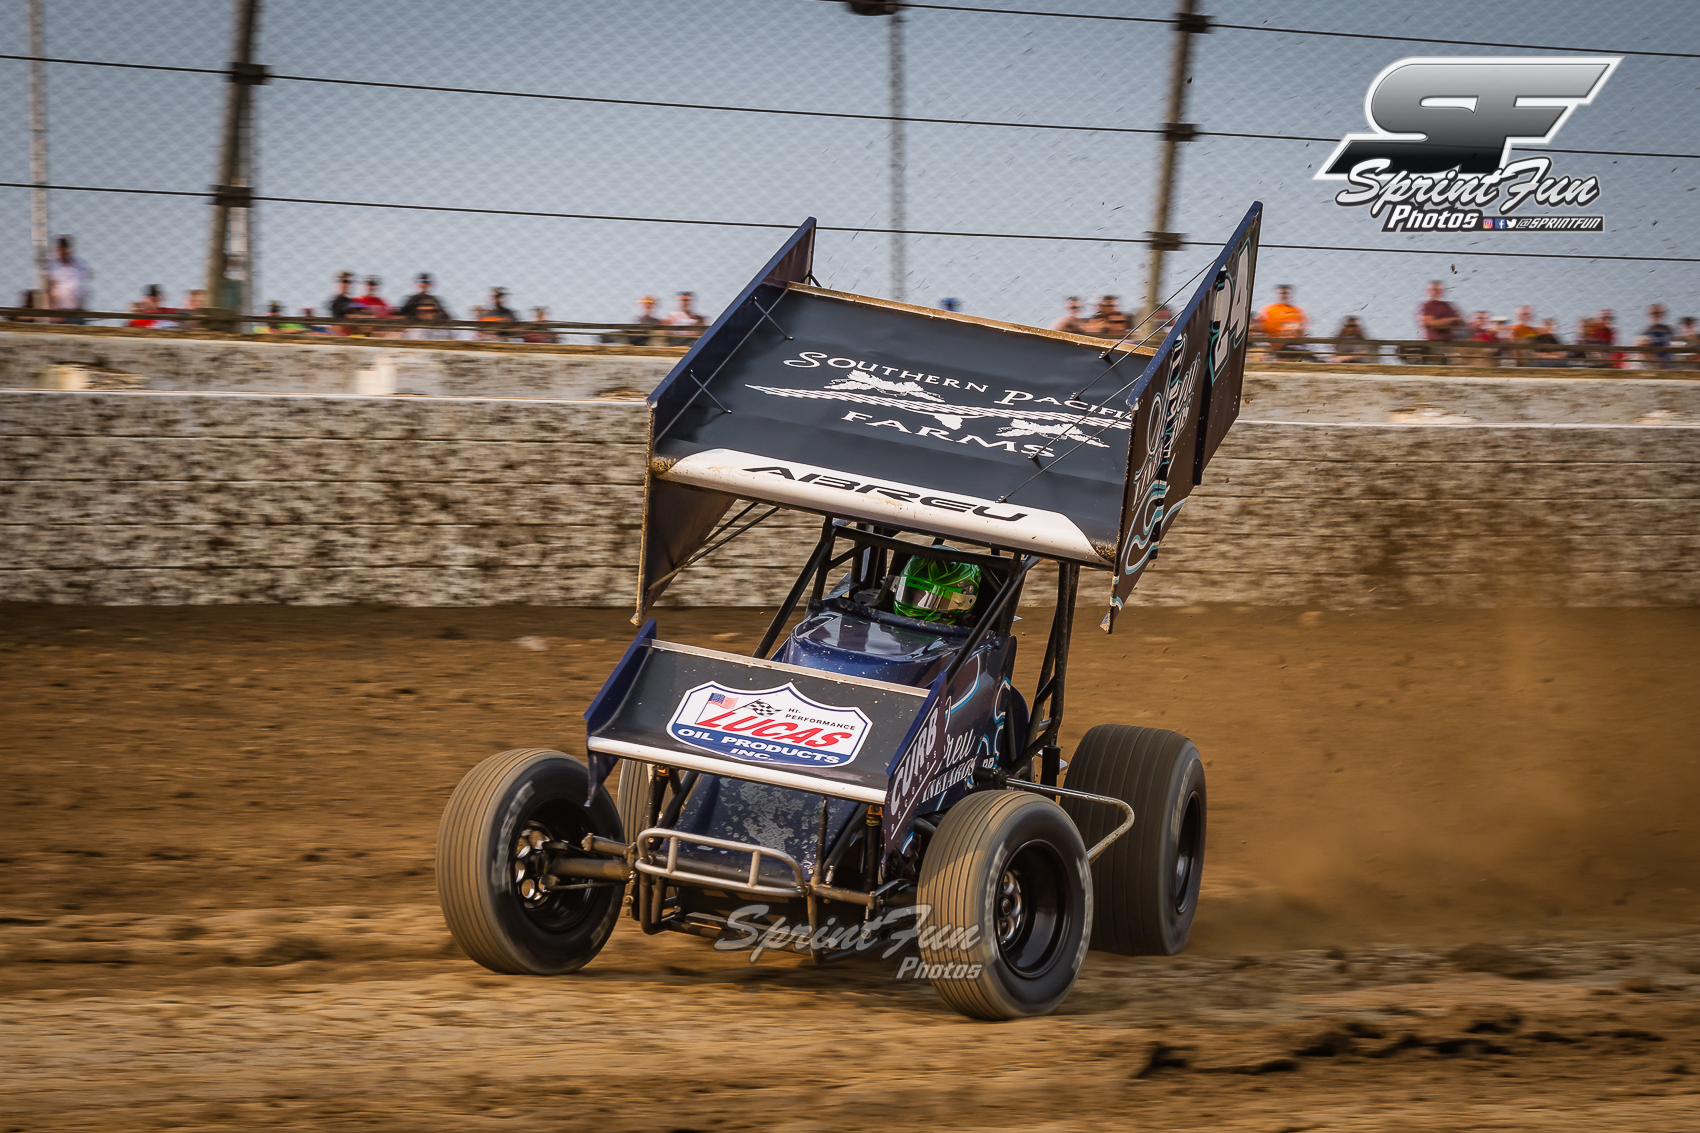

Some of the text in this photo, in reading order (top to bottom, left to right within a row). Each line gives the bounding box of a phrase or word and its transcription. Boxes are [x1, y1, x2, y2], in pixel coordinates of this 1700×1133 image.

[1203, 243, 1250, 376] 24
[782, 351, 989, 393] SOUTHERN
[840, 410, 1056, 458] FARMS
[742, 466, 1028, 522] ABREU
[694, 711, 853, 748] LUCAS
[785, 713, 856, 731] PERFORMANCE
[677, 728, 841, 764] OIL PRODUCTS
[730, 747, 774, 761] INC.
[890, 706, 938, 816] CURB
